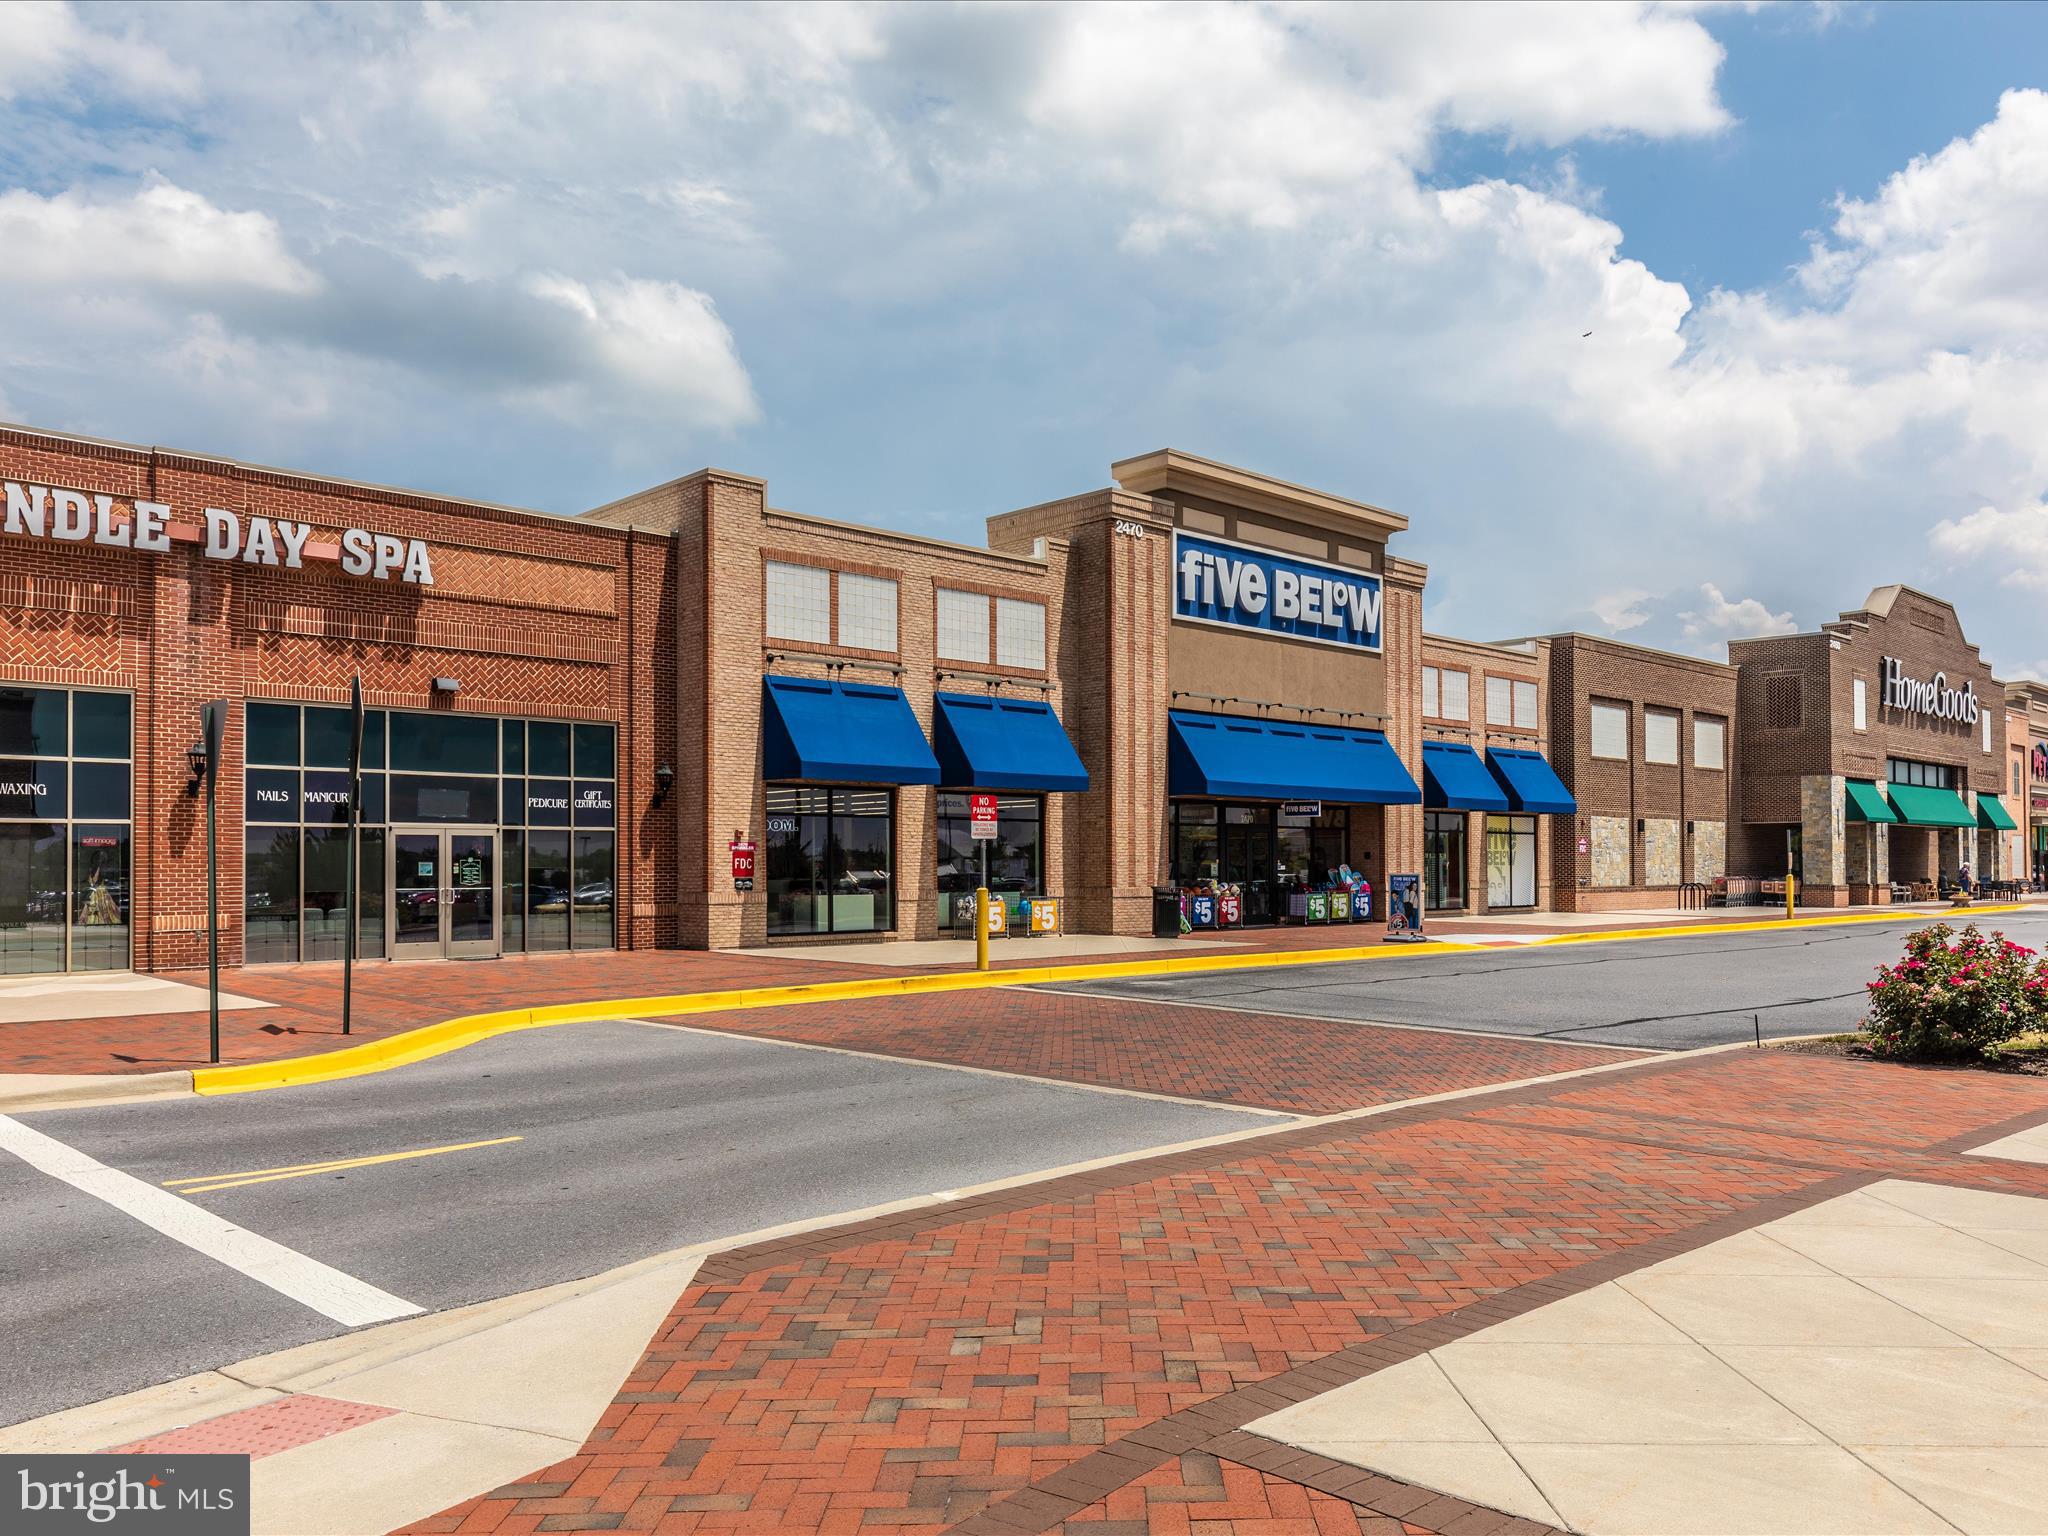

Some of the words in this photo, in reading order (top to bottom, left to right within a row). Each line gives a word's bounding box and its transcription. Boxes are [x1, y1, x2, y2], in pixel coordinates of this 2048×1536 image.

[1115, 520, 1143, 538] 2470
[203, 508, 310, 568] DAY
[341, 528, 433, 585] SPA
[1881, 656, 1978, 725] HomeGoods
[0, 783, 47, 796] WAXING
[257, 790, 289, 802] NAILS
[583, 790, 602, 800] GIFT
[304, 792, 350, 803] MANICUR
[528, 797, 568, 809] PEDICURE
[574, 800, 612, 809] CERTIFICATES
[979, 797, 989, 806] NO
[972, 806, 996, 815] PARKING
[734, 858, 753, 869] FDC
[1195, 900, 1212, 923] $5
[1221, 900, 1239, 922] $5
[1310, 898, 1326, 919] $5
[1333, 897, 1348, 917] $5
[1355, 896, 1370, 917] $5
[1034, 905, 1056, 930] $5
